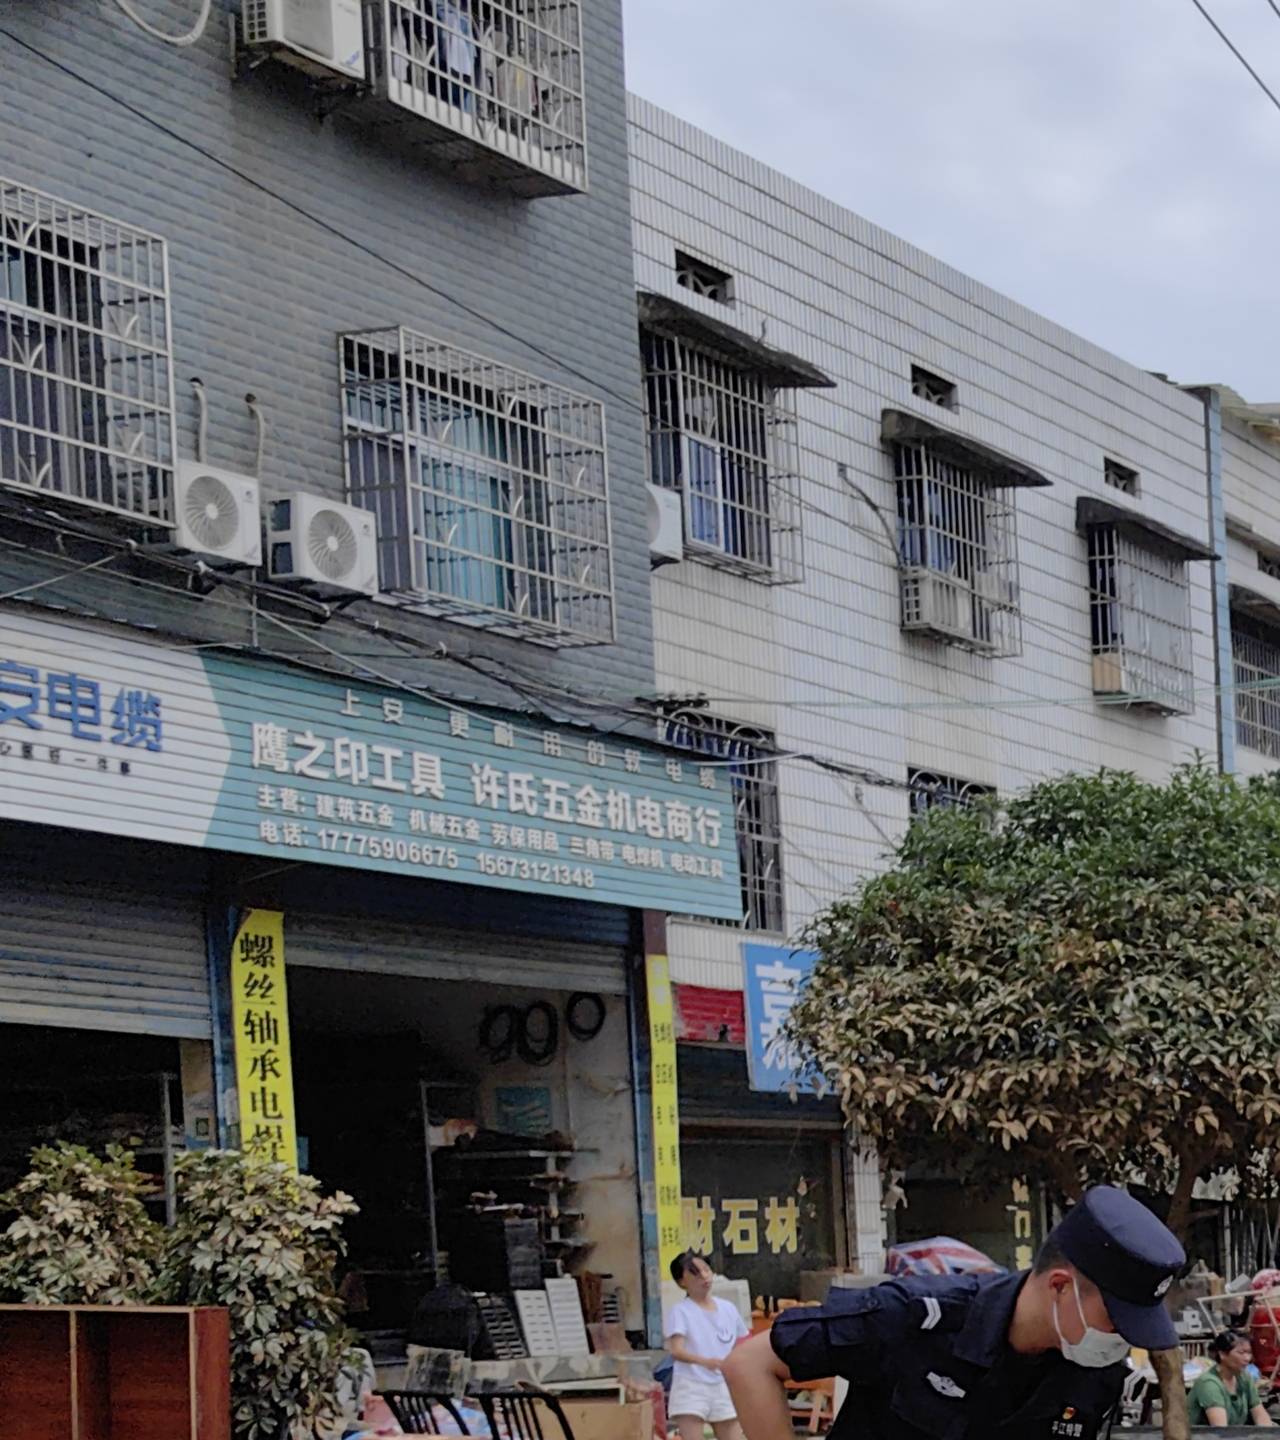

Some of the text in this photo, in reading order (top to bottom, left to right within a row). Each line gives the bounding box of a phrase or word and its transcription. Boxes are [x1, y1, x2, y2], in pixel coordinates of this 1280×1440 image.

[340, 688, 404, 725] 上安
[251, 722, 723, 848] 鹰之印工具 许氏五金机电商行
[316, 795, 395, 827] 建筑五金
[409, 809, 481, 842] 机械五金
[491, 822, 560, 852] 劳保用品
[569, 836, 615, 861] 三角带
[622, 845, 665, 869] 电焊机
[670, 853, 724, 879] 电动工具
[318, 829, 460, 869] 17775906675
[476, 853, 596, 889] 15673121348
